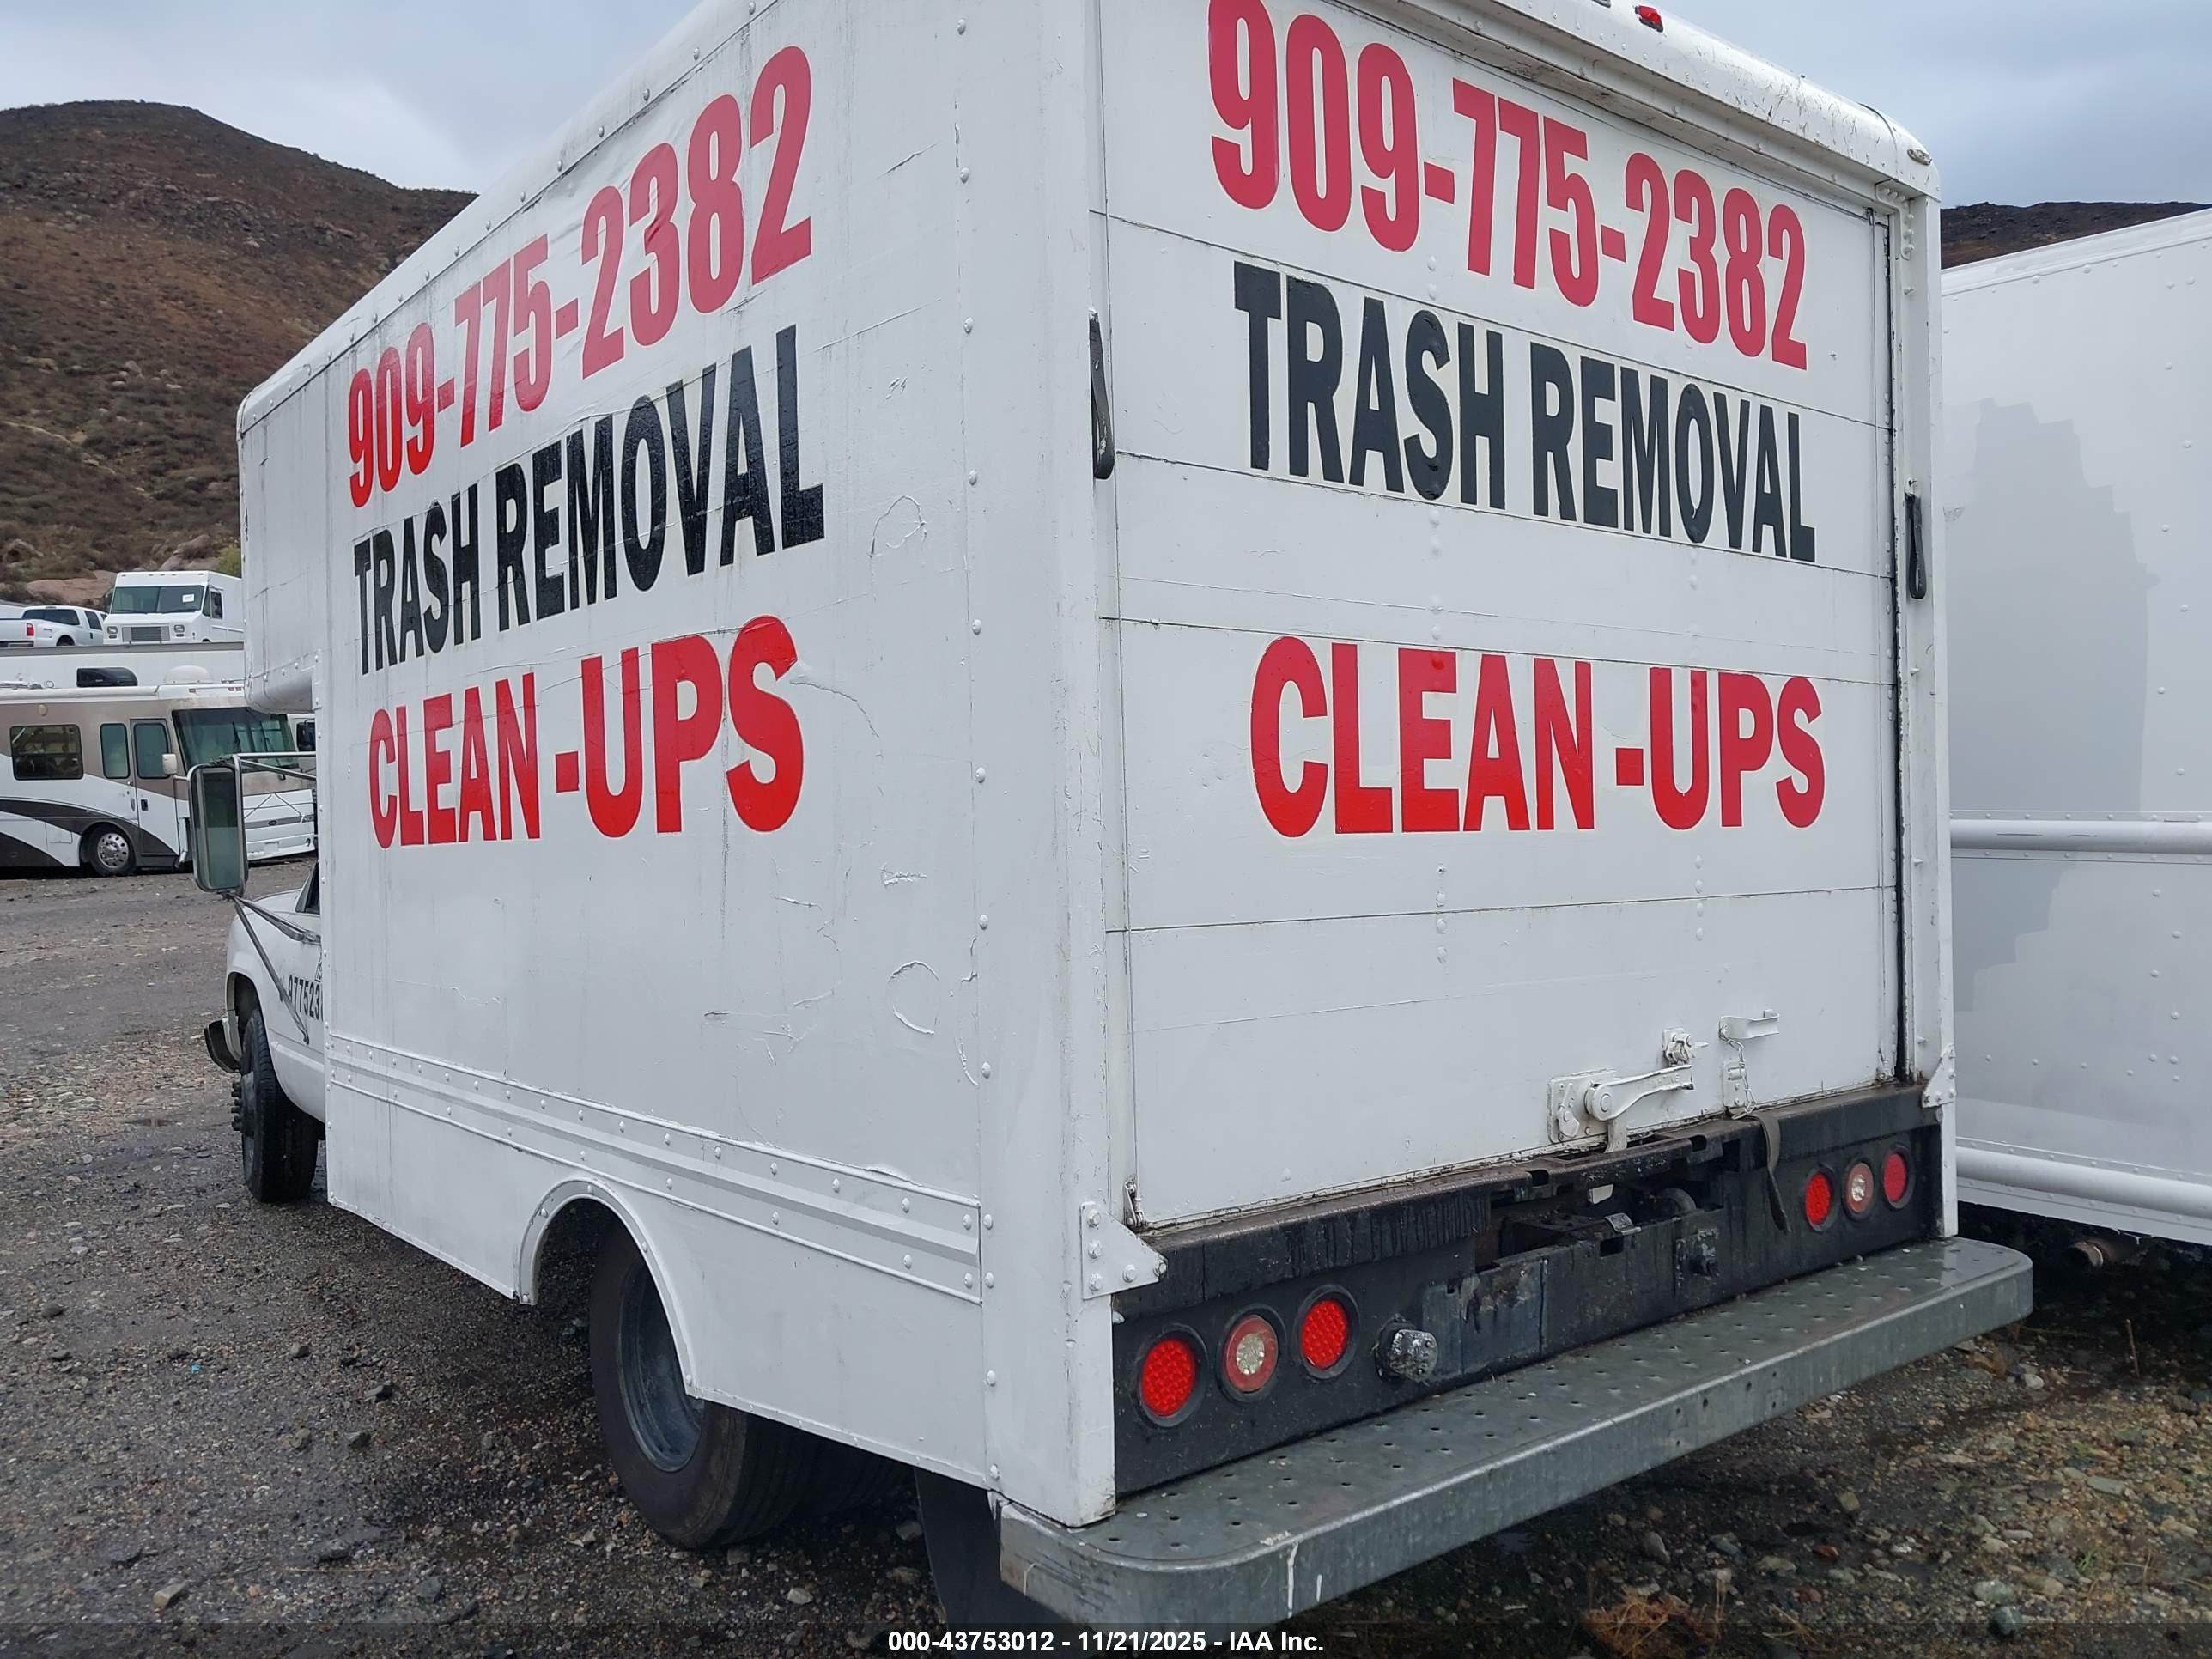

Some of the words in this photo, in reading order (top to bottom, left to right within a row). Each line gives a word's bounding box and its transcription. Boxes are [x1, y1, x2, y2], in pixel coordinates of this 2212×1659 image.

[348, 46, 811, 508] 909-775-2382
[1209, 0, 1808, 370] 909-775-2382
[353, 482, 483, 676] TRASH
[495, 323, 826, 633] REMOVAL
[1234, 260, 1506, 511] TRASH
[1529, 341, 1816, 563] REMOVAL
[368, 615, 805, 849] CLEAN-UPS
[1250, 636, 1826, 838] CLEAN-UPS
[288, 975, 324, 1022] 977523
